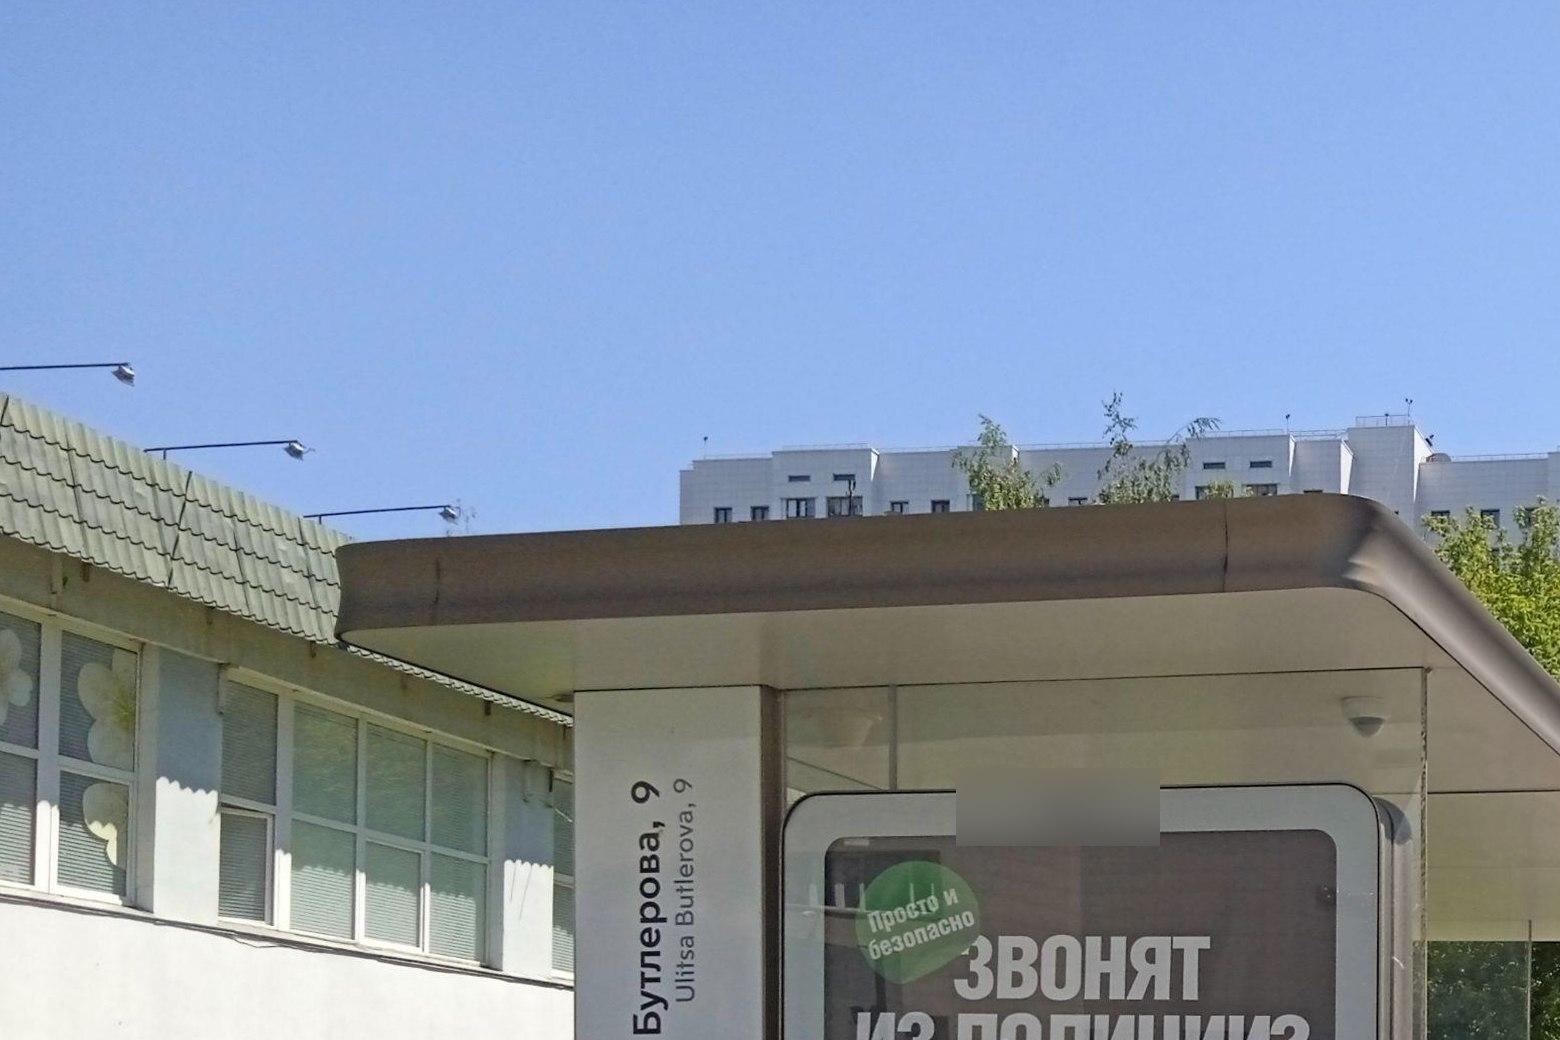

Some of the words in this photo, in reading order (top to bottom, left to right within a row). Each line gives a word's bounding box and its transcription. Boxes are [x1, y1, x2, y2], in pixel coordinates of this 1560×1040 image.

[631, 780, 660, 804] 9
[673, 778, 693, 793] 9
[673, 803, 696, 926] Butlerova,
[633, 821, 668, 1035] Бутлерова,
[867, 895, 939, 933] Просто
[943, 888, 959, 906] и
[868, 910, 975, 960] безопасно
[674, 935, 695, 1002] Ulitsa
[953, 934, 1210, 1001] ЗВОНЯТ
